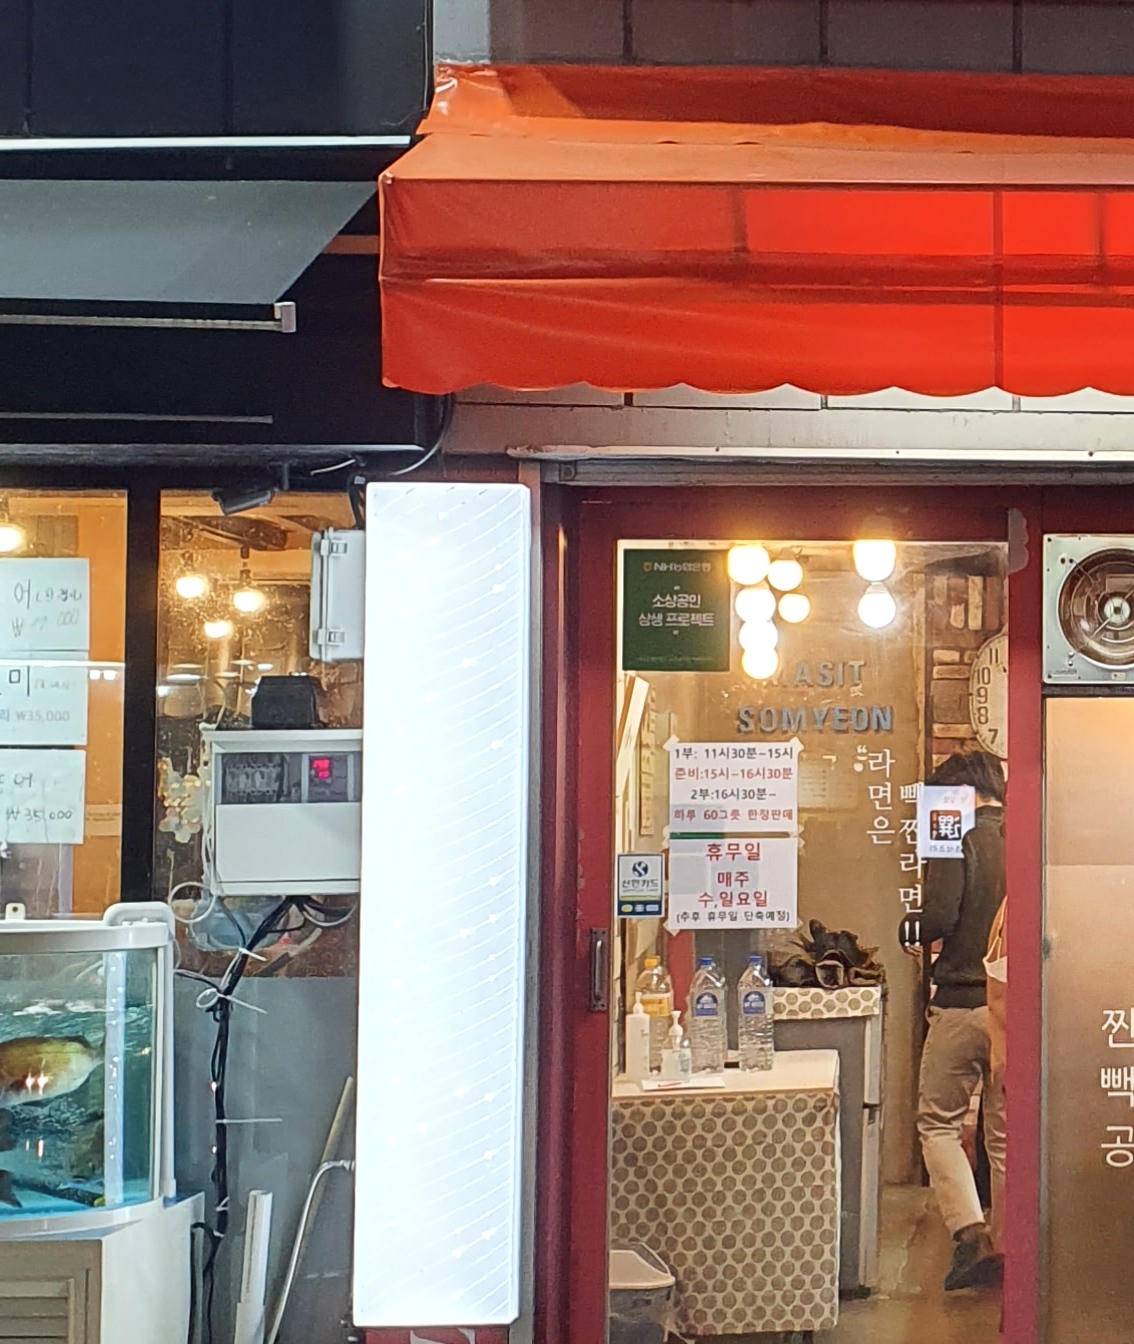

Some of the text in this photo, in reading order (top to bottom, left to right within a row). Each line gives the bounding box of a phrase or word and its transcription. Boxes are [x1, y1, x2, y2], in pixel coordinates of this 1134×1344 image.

[652, 593, 701, 609] 소상공인
[638, 612, 715, 627] 상생 프로젝트
[976, 686, 989, 705] 9
[737, 705, 893, 734] SOMYEON
[988, 729, 999, 746] 7
[706, 842, 761, 861] 휴무일
[717, 871, 750, 888] 매주
